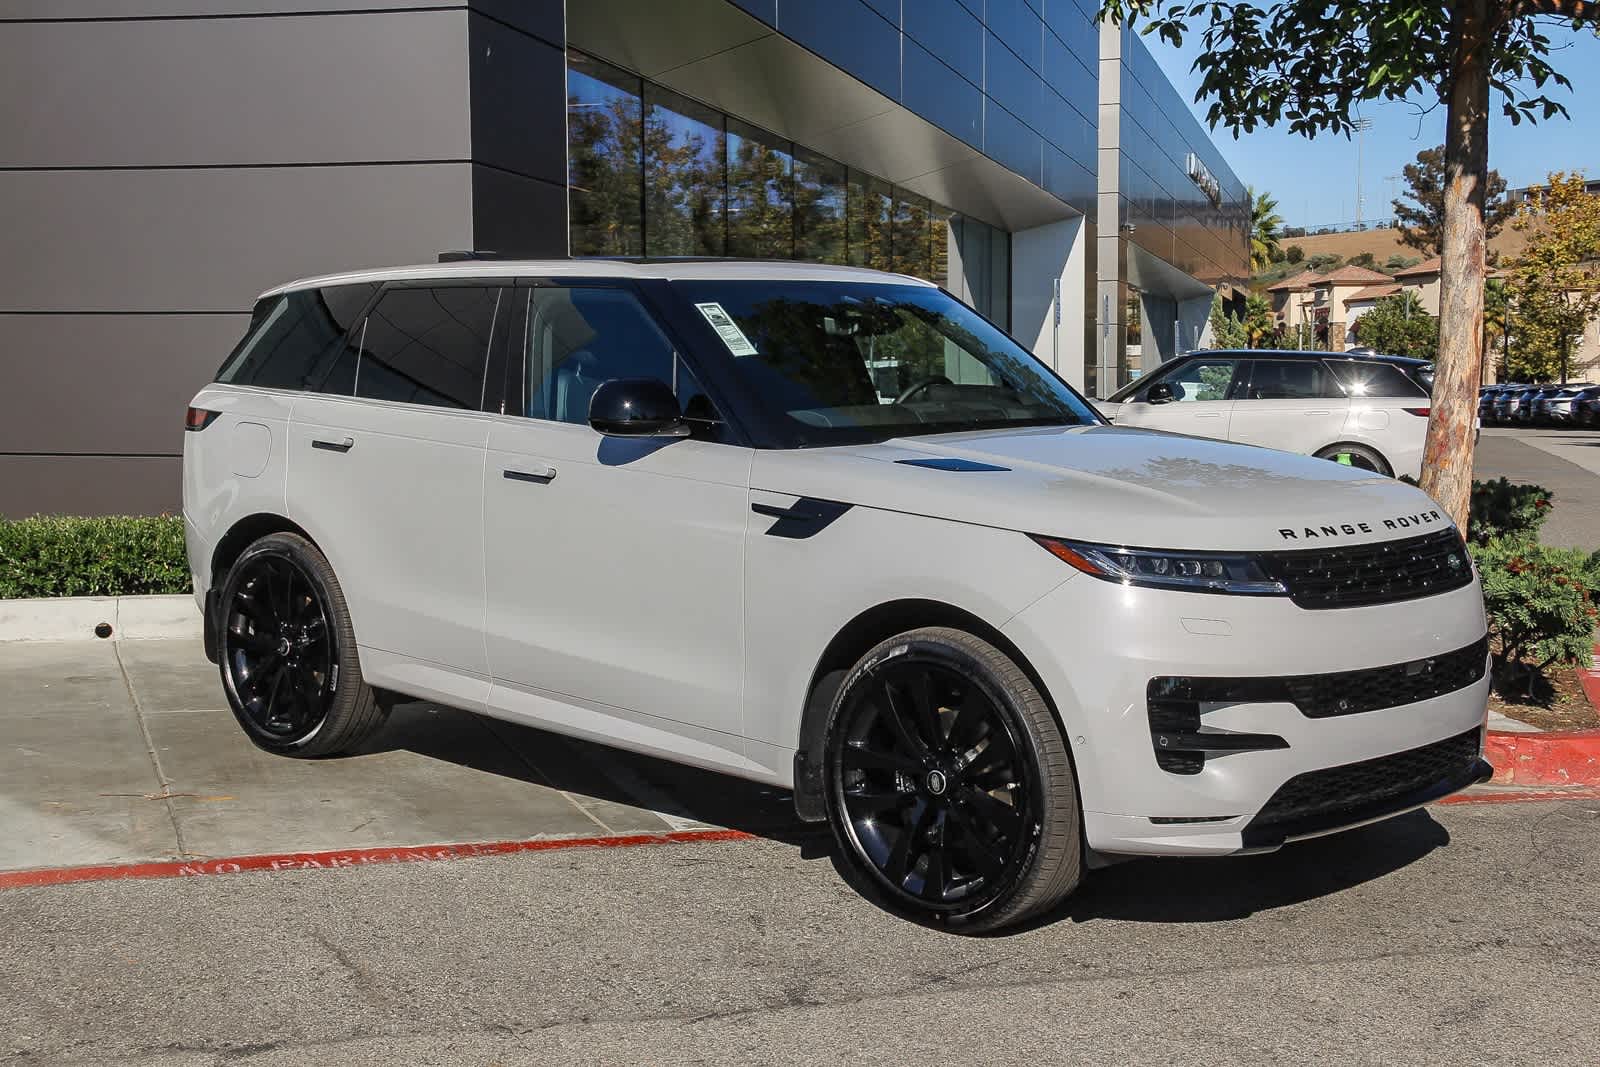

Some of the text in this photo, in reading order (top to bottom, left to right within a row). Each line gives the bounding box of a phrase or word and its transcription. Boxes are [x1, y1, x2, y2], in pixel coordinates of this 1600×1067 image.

[1279, 510, 1441, 540] RANGE ROVER
[179, 863, 241, 876] NO
